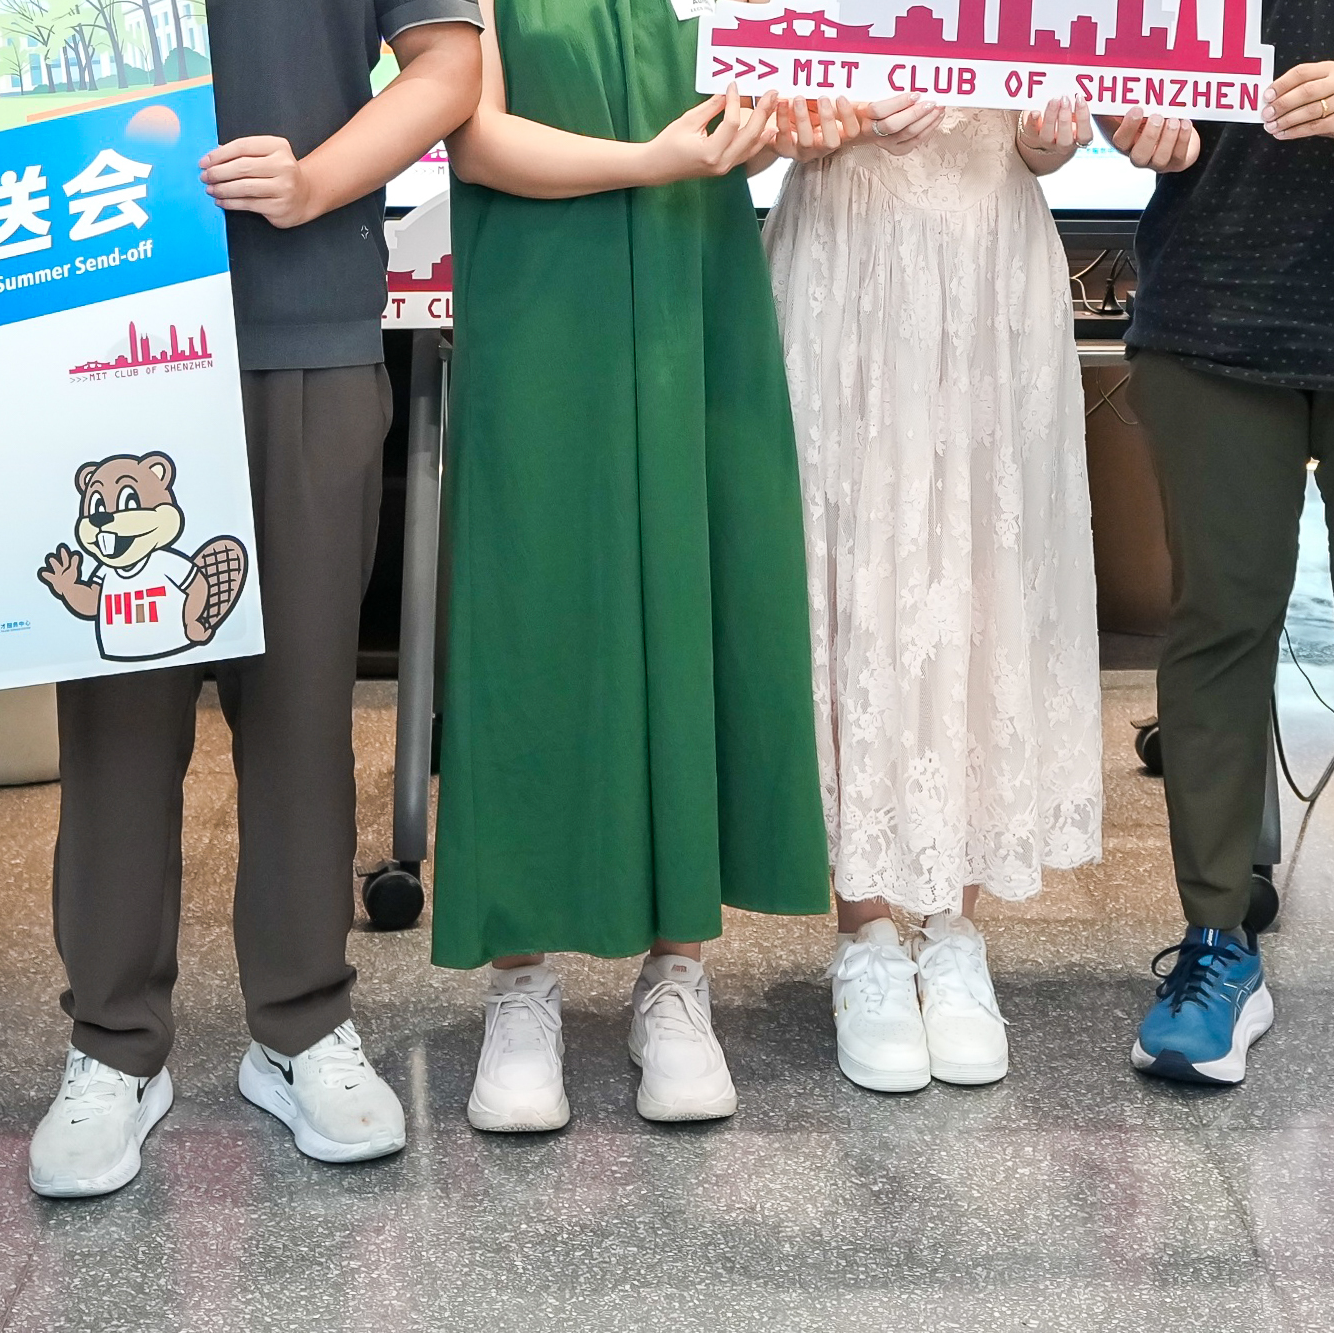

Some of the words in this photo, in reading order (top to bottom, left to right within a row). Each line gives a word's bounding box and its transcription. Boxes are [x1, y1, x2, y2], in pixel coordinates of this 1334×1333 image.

[793, 59, 860, 88] MIT
[887, 64, 976, 95] CLUB
[1004, 71, 1048, 100] OF
[1076, 74, 1260, 112] SHENZHEN
[74, 239, 154, 279] Send-off
[114, 369, 139, 379] CLUB
[145, 366, 158, 375] OF
[164, 360, 214, 373] SHENZHEN
